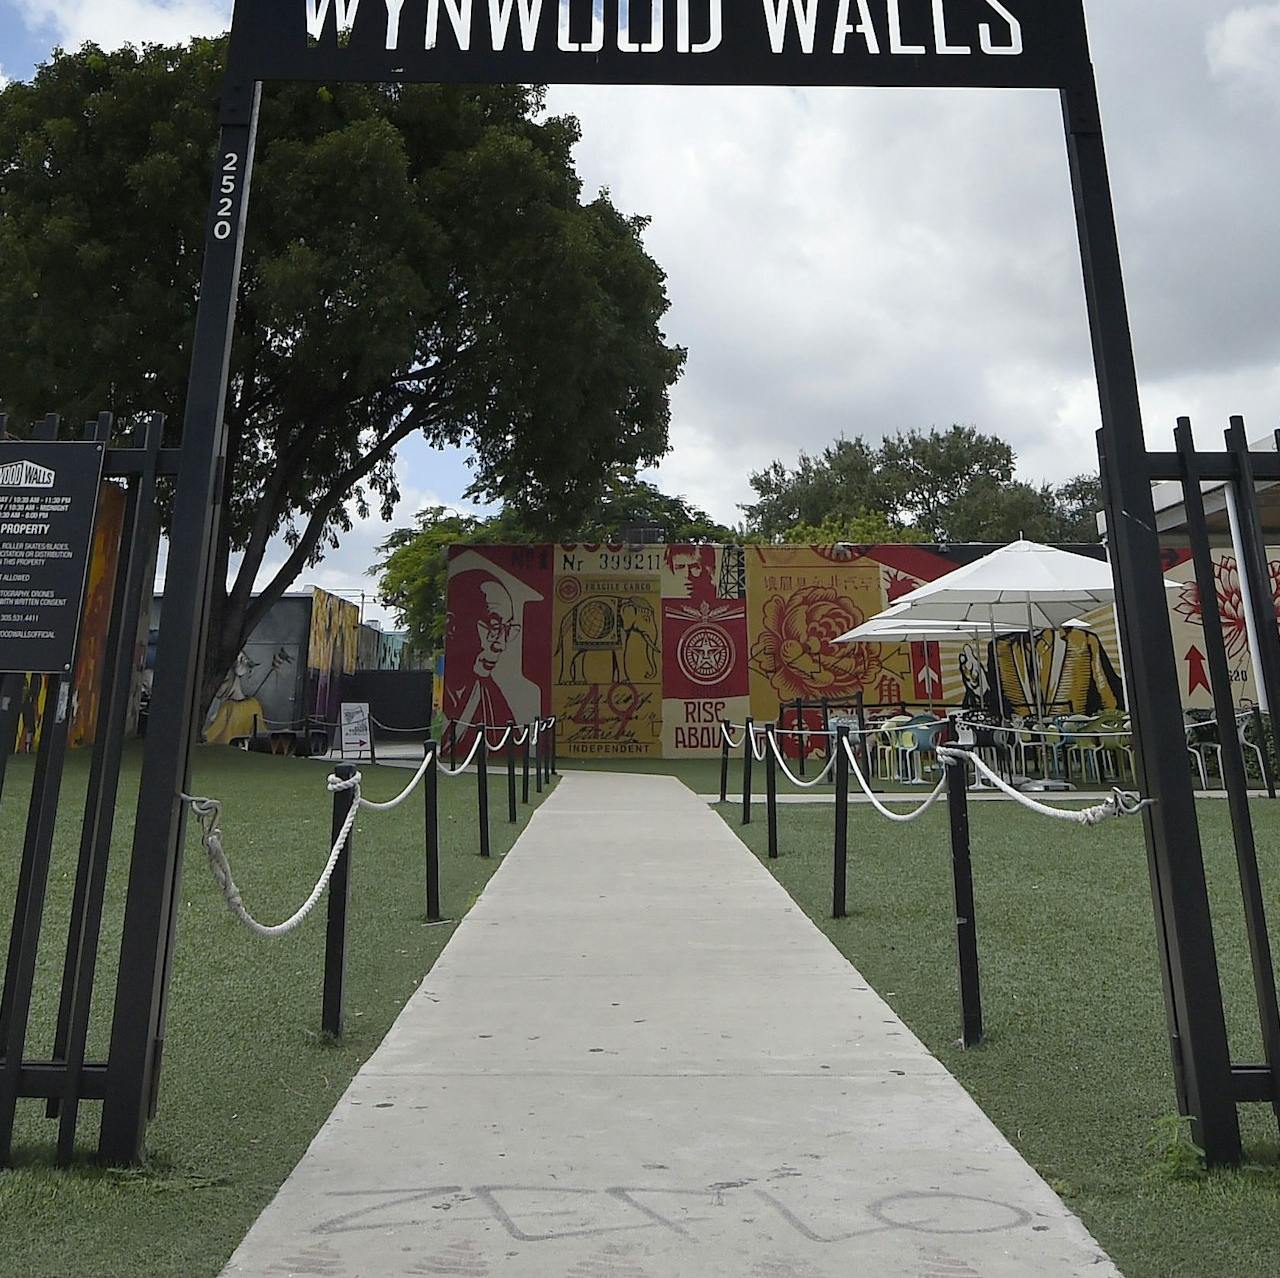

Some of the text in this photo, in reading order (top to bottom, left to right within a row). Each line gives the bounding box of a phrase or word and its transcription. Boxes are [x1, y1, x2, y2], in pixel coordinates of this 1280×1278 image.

[213, 152, 239, 240] 2520
[25, 464, 53, 485] WALLS
[0, 524, 51, 534] PROPERTY
[563, 554, 583, 572] Nr
[599, 553, 661, 570] 399211
[585, 582, 651, 591] FRAGILE CARGO
[573, 682, 640, 739] 49
[683, 701, 726, 723] RISE
[568, 744, 650, 754] INDEPENDENT
